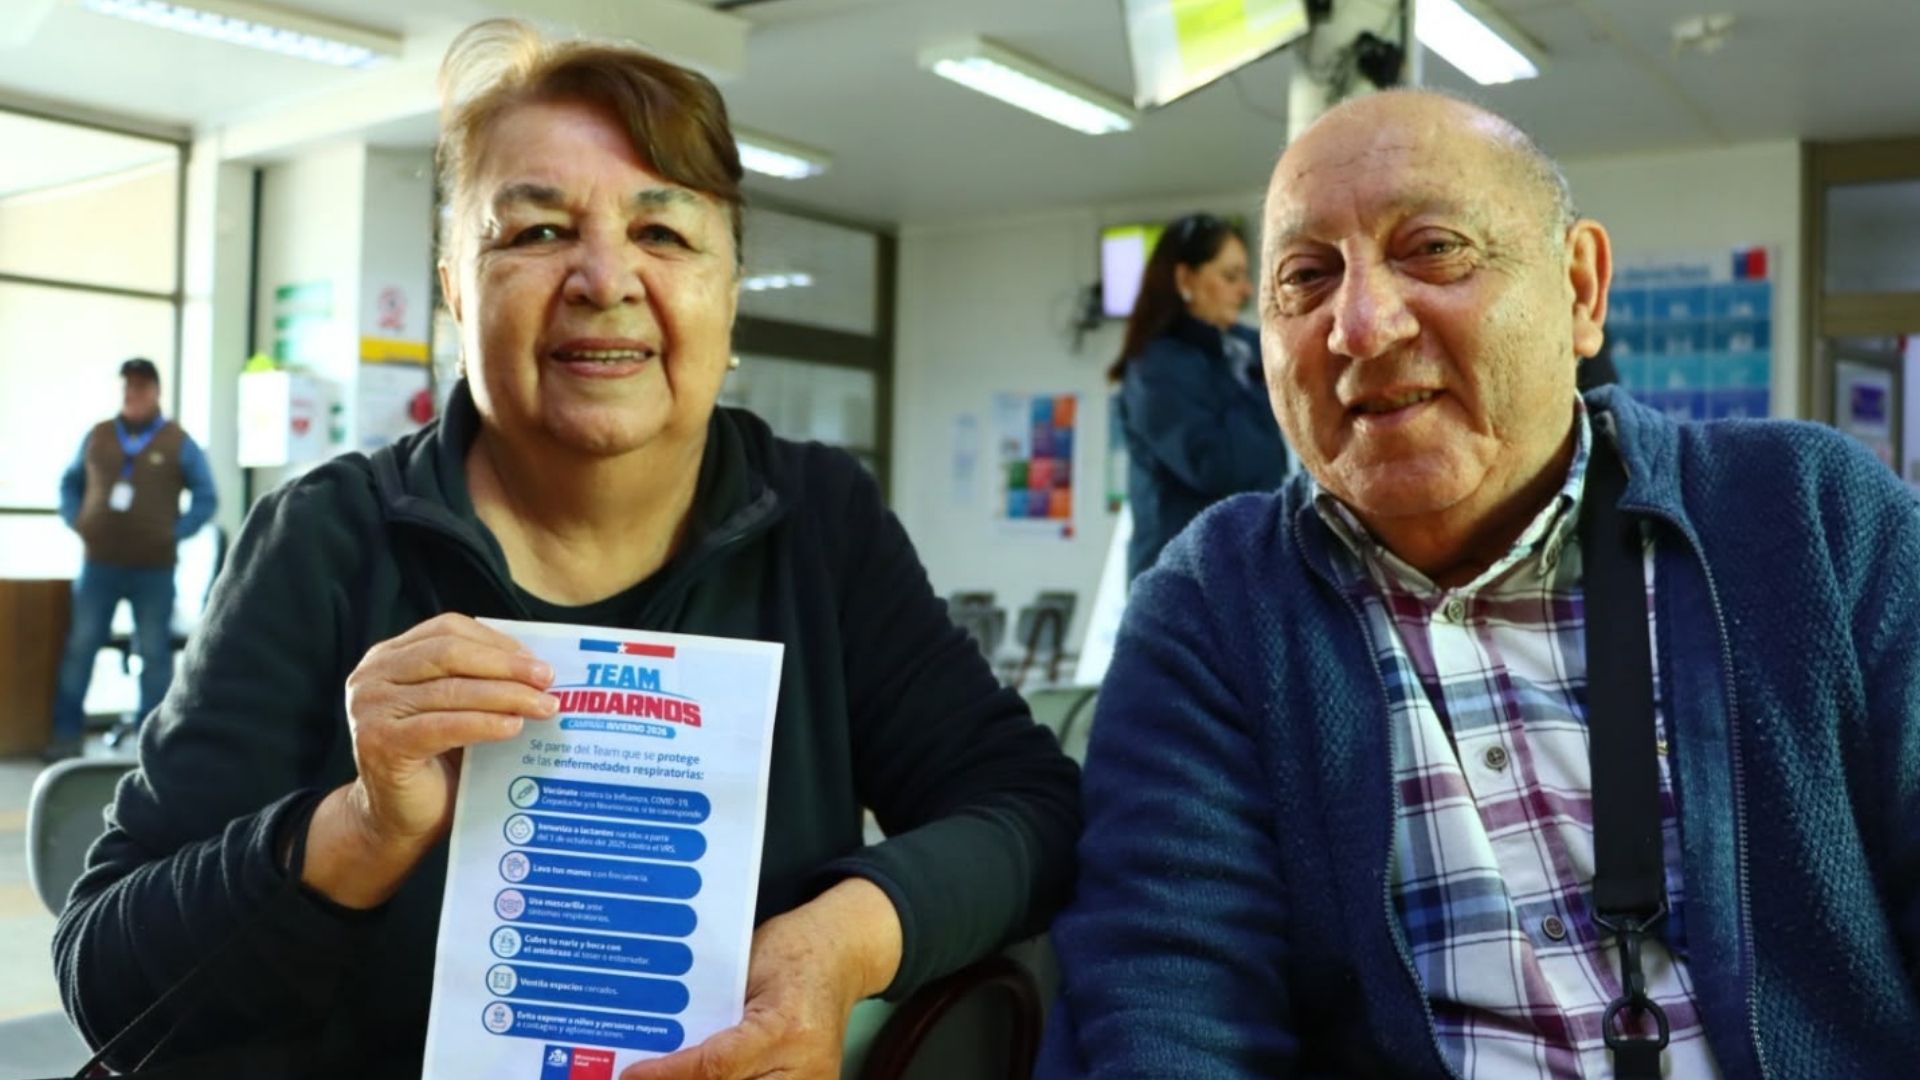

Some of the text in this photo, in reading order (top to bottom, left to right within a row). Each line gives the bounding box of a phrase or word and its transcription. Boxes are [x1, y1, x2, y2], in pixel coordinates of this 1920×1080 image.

[586, 662, 661, 691] TEAM
[548, 691, 702, 727] UIDARNOS
[606, 721, 645, 734] INVIERNO
[646, 725, 667, 737] 2026
[545, 742, 571, 753] parte
[574, 744, 590, 754] del
[594, 745, 620, 757] Team
[622, 750, 641, 761] que
[644, 752, 655, 761] se
[658, 752, 700, 767] protege
[522, 755, 705, 780] de las enfermedades respiratorias:
[580, 790, 604, 799] contra
[605, 792, 613, 800] la
[580, 825, 614, 838] lactantes
[555, 834, 564, 843] de
[566, 835, 593, 846] octubre
[627, 842, 651, 852] contra
[533, 864, 551, 873] Lava
[553, 866, 565, 875] tus
[566, 868, 592, 878] manos
[593, 871, 607, 879] con
[529, 896, 604, 912] Usa mascarilla ante
[525, 934, 547, 945] Cubre
[549, 937, 558, 946] tu
[559, 938, 579, 948] nariz
[587, 940, 605, 950] boca
[606, 944, 622, 952] con
[524, 945, 532, 954] el
[533, 946, 572, 957] antebrazo
[573, 949, 581, 958] al
[581, 951, 600, 961] toser
[520, 977, 549, 988] Ventila
[550, 980, 583, 992] espacios
[517, 1010, 536, 1021] Evita
[537, 1014, 568, 1024] exponer
[574, 1017, 594, 1027] niños
[601, 1021, 635, 1032] personas
[636, 1024, 668, 1035] mayores
[522, 1020, 558, 1033] contagios
